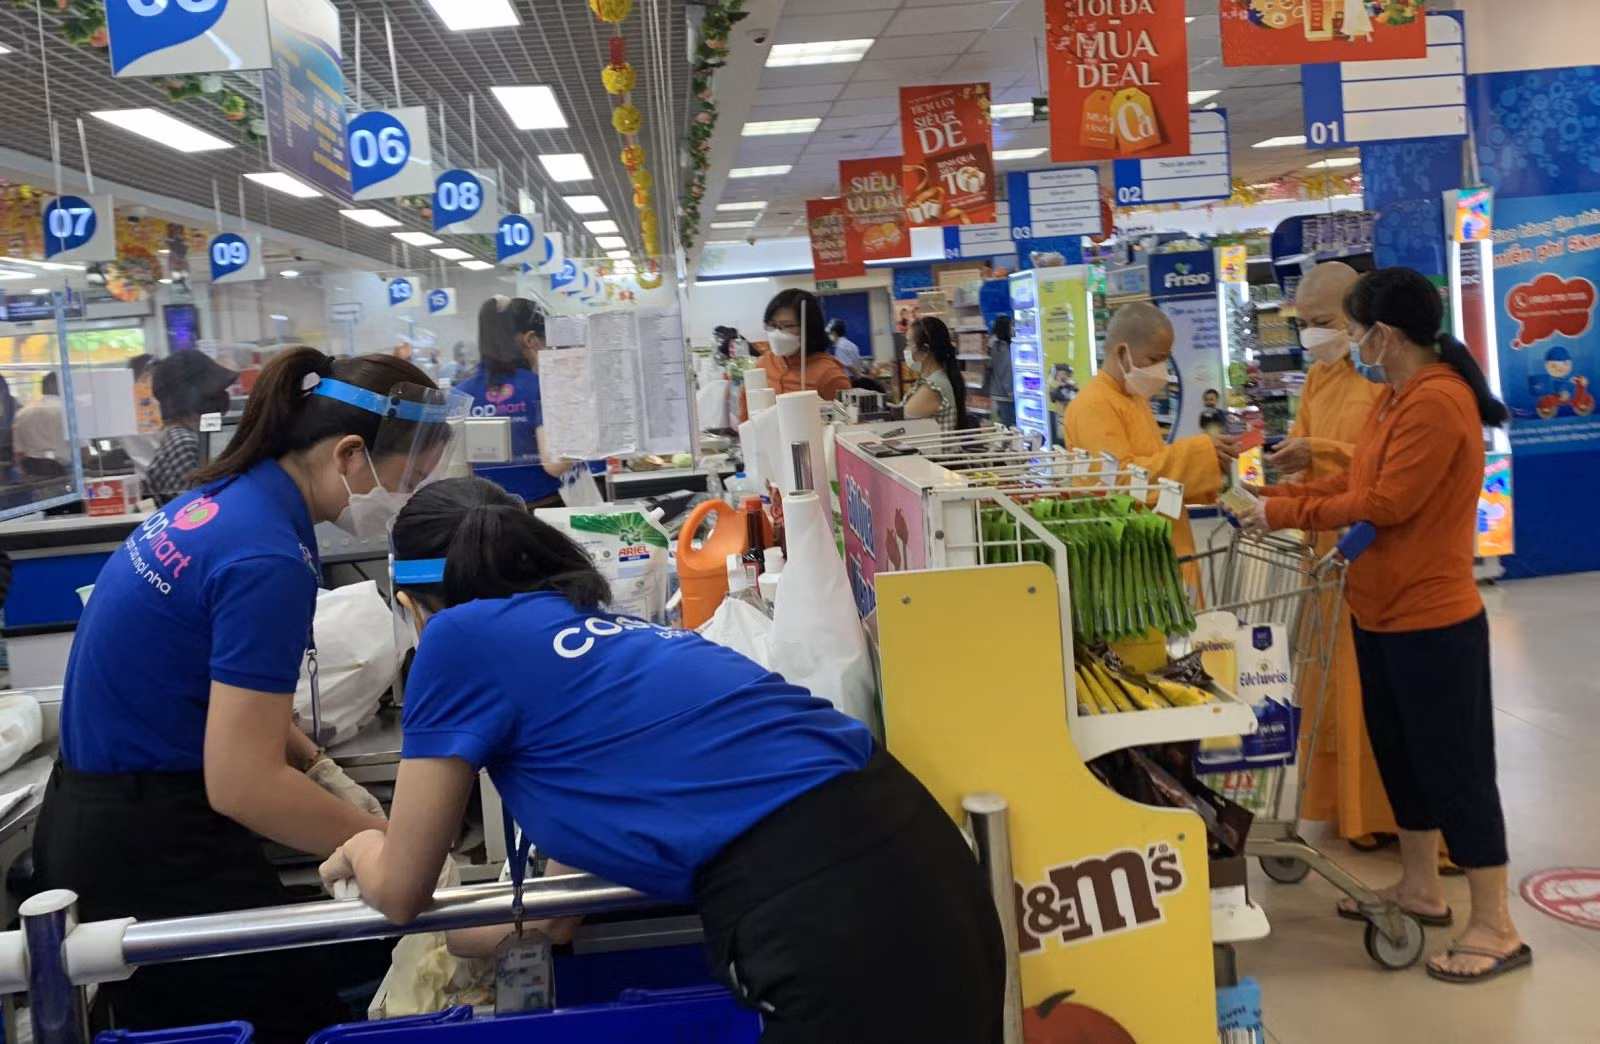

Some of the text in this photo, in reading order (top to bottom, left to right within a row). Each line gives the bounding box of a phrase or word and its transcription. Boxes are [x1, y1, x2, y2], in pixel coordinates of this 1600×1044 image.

[1076, 30, 1159, 60] MUA
[1075, 61, 1161, 88] DEAL
[1311, 122, 1339, 144] 01
[350, 126, 406, 167] 06
[438, 181, 480, 211] 08
[1118, 186, 1141, 203] 02
[49, 208, 90, 238] 07
[499, 223, 530, 246] 10
[1012, 226, 1032, 240] 03
[212, 241, 244, 265] 09
[389, 283, 411, 298] 13
[618, 544, 650, 556] ARIEL
[1239, 670, 1289, 688] Edelweiss
